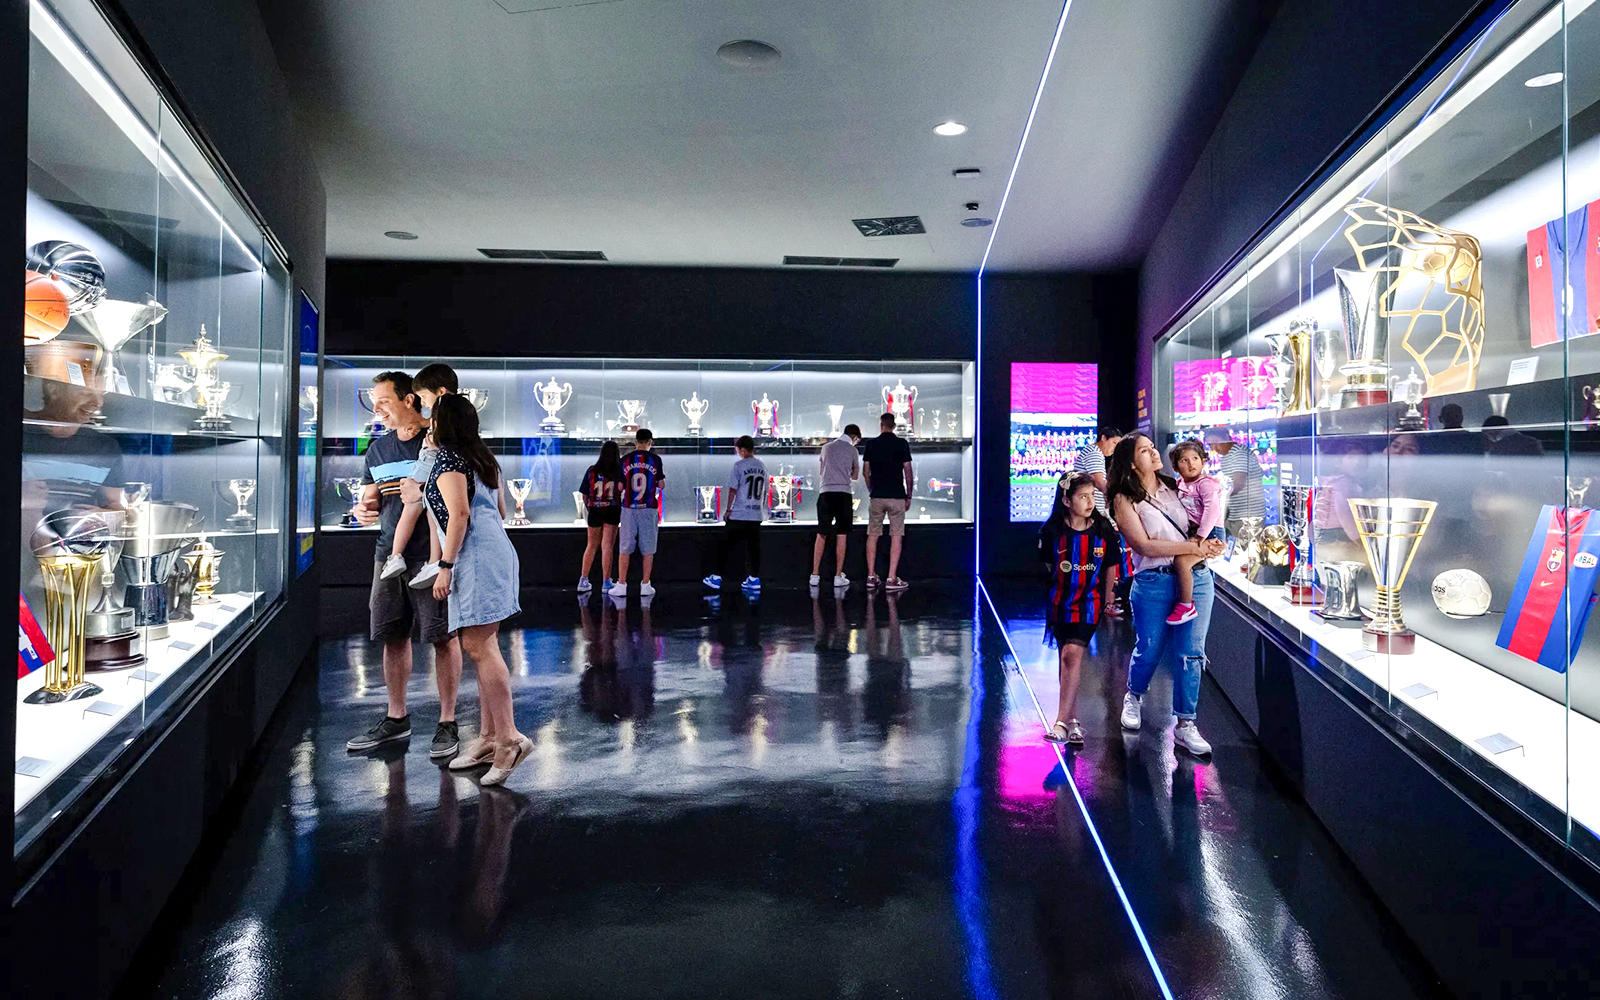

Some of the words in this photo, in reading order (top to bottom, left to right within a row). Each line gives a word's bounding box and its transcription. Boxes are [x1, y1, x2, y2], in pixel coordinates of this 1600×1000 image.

[594, 481, 615, 499] 11
[631, 473, 647, 500] 9
[745, 475, 764, 500] 10
[1073, 563, 1097, 572] Spotify
